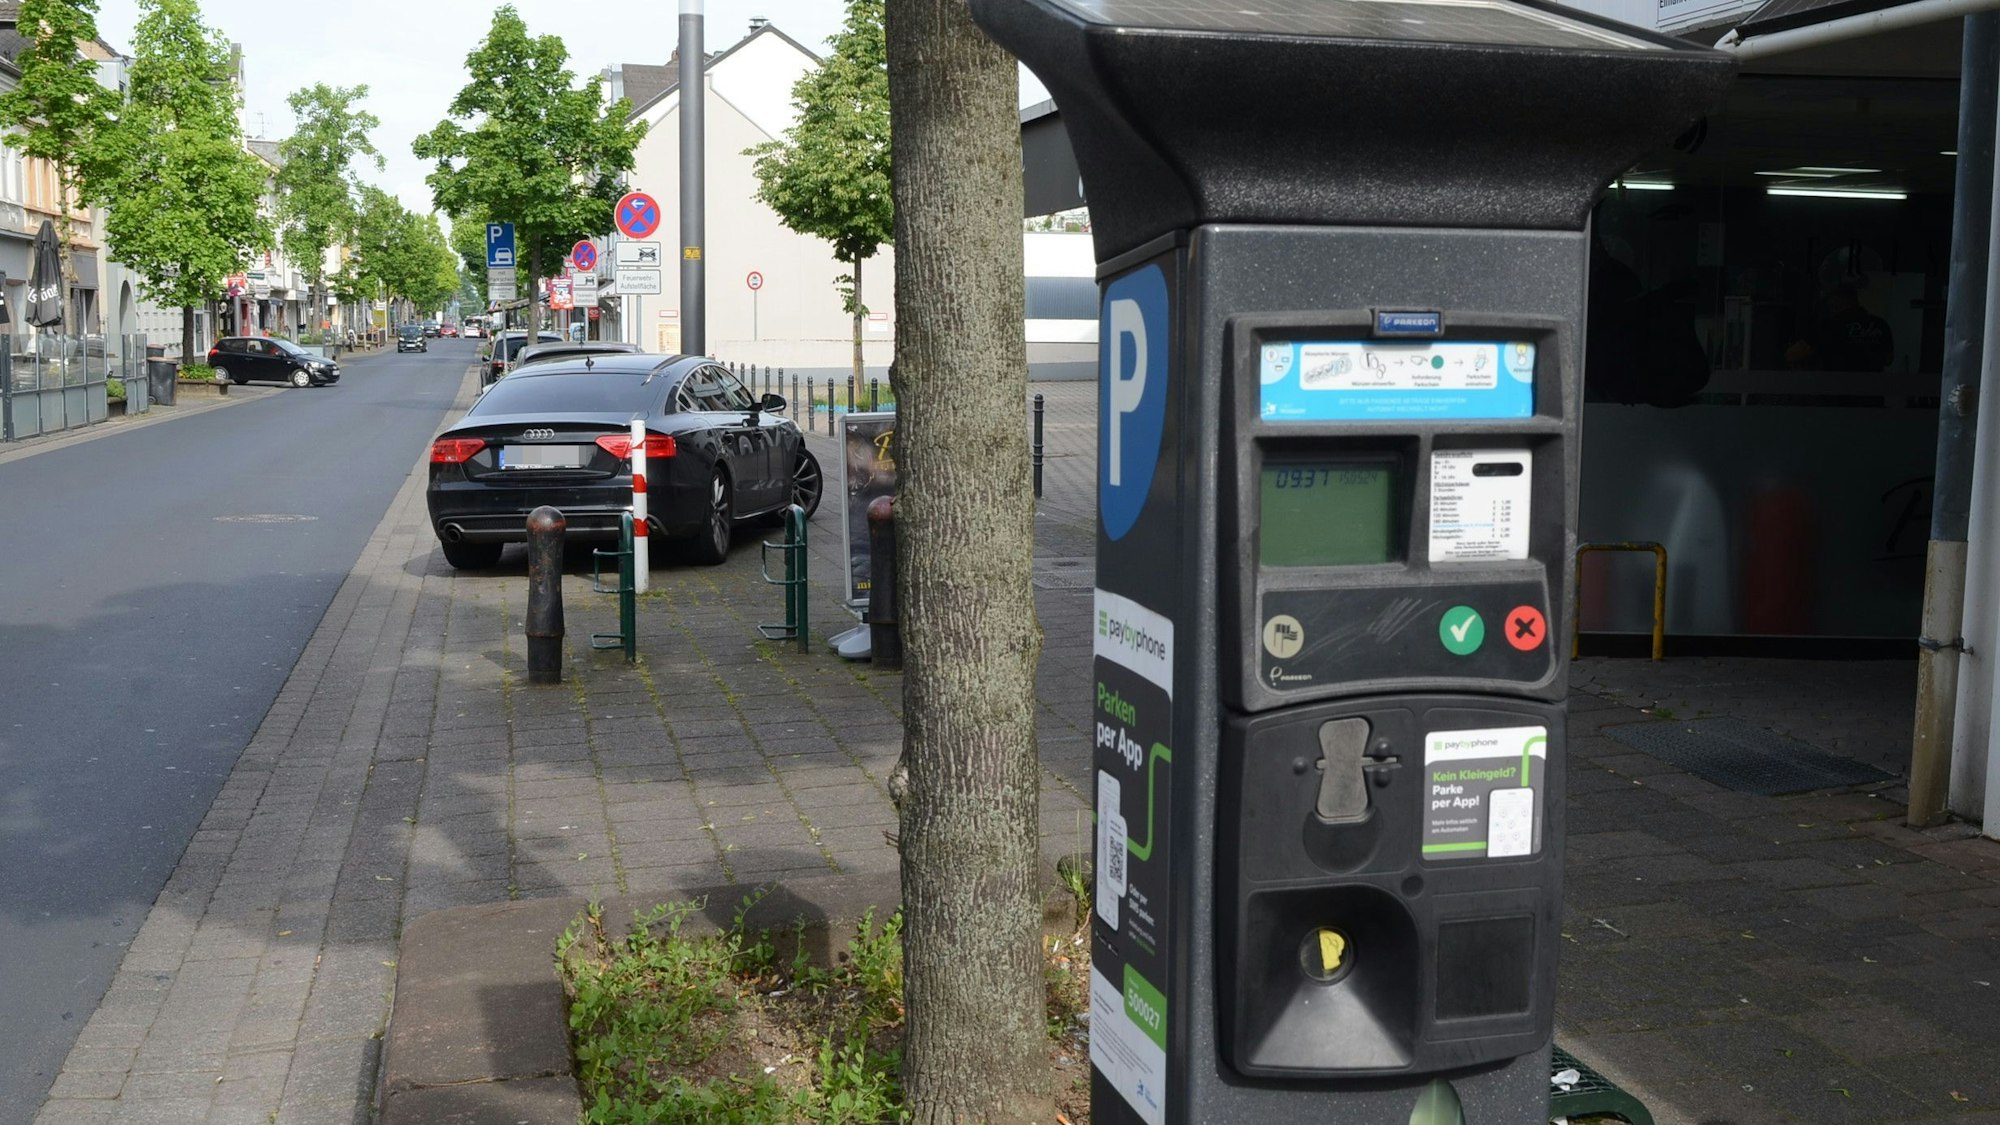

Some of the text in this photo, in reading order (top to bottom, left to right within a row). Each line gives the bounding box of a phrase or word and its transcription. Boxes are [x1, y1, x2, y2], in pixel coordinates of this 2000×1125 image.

[490, 226, 503, 243] P
[620, 282, 657, 290] Aufstellfläche
[622, 274, 654, 282] Feuerwehr-
[1109, 299, 1148, 486] P
[1109, 618, 1166, 661] paybyphone
[1097, 682, 1136, 727] Parken
[1096, 721, 1143, 772] per App
[1445, 738, 1498, 750] paybyphone
[1433, 767, 1516, 782] Kein Kleingeld?
[1432, 784, 1464, 796] Parke
[1431, 795, 1480, 811] per App!
[1128, 987, 1160, 1030] 500027
